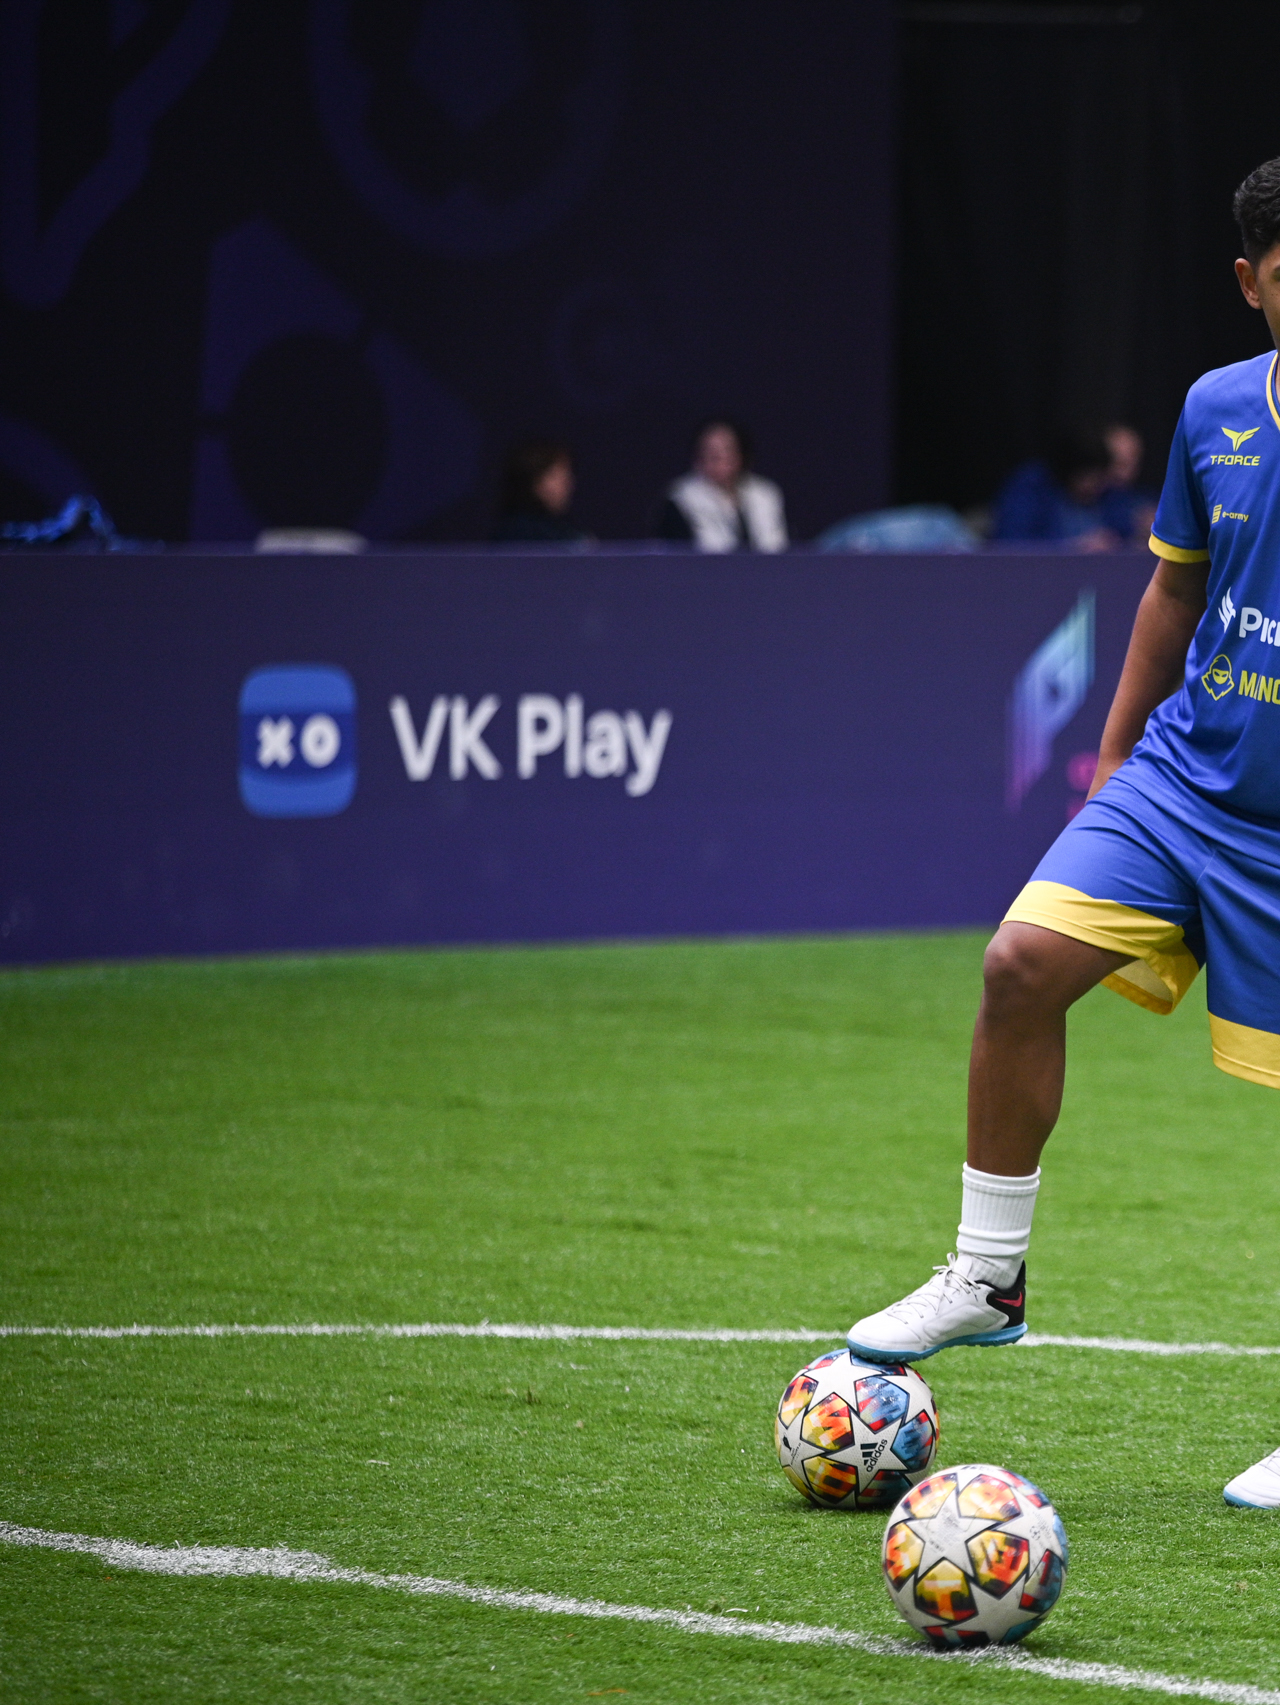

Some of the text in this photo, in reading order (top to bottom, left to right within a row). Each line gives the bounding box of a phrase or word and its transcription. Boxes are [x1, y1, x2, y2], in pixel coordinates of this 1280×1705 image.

[1210, 455, 1261, 467] T-FORCE
[390, 692, 672, 797] VK Play
[866, 1439, 888, 1473] adidas
